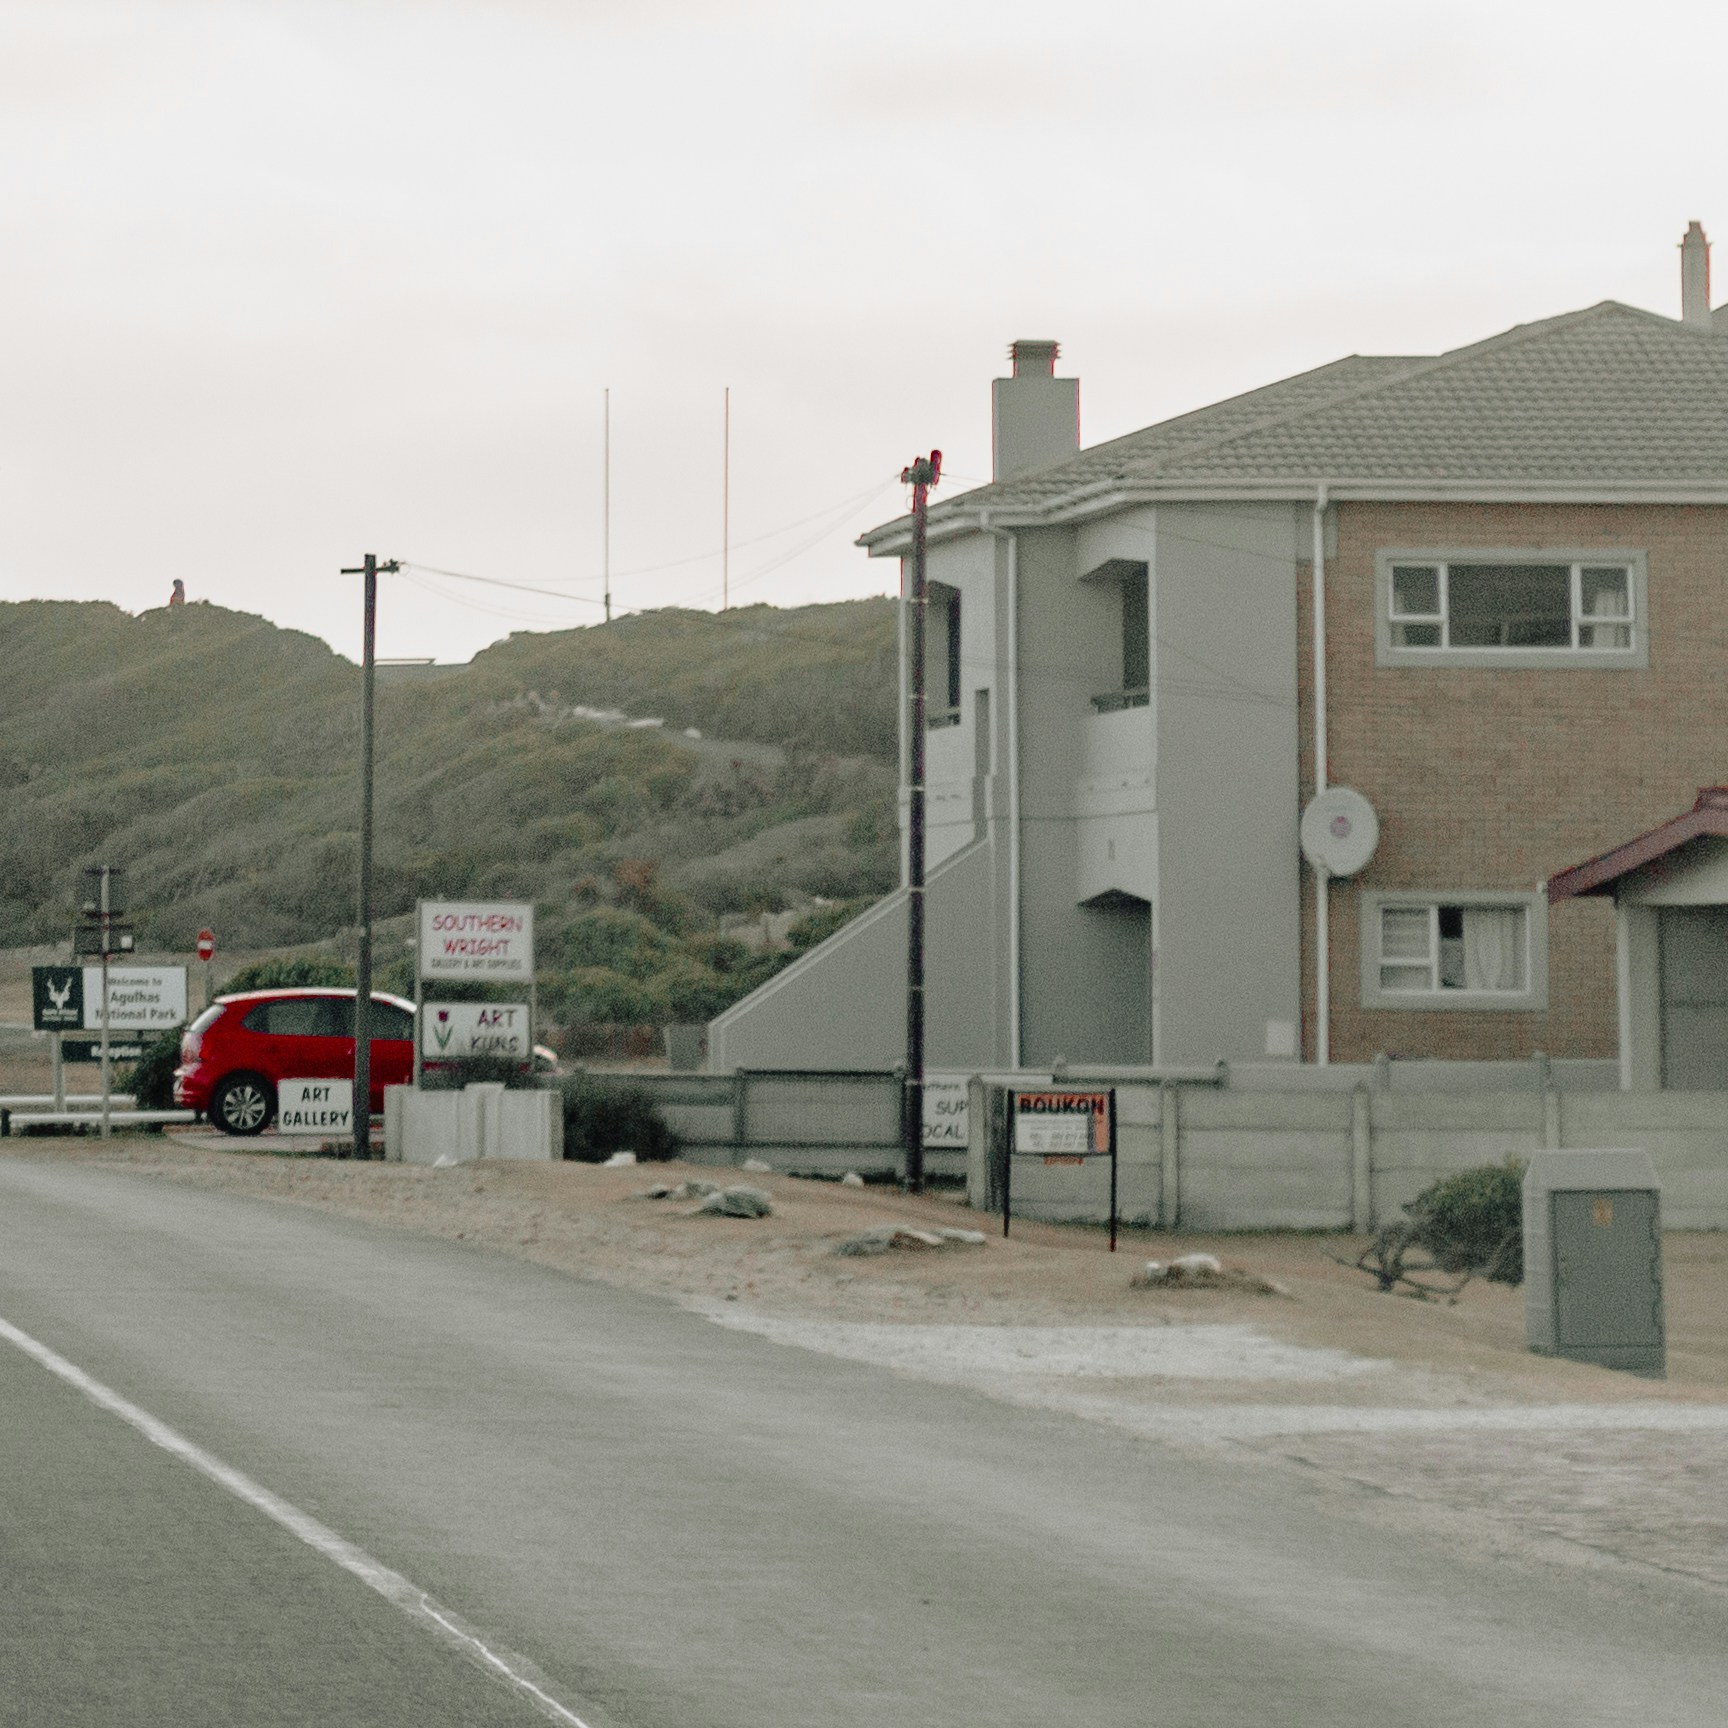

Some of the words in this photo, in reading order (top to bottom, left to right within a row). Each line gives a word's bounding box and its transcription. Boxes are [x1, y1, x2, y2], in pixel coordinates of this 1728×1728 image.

[432, 914, 522, 932] SOUTHERN
[444, 938, 509, 955] WRIGHT
[152, 977, 162, 986] to
[110, 991, 160, 1006] Agulhas
[150, 1008, 176, 1020] Park
[477, 1009, 518, 1027] ART
[302, 1087, 331, 1102] ART
[282, 1111, 349, 1127] GALLERY
